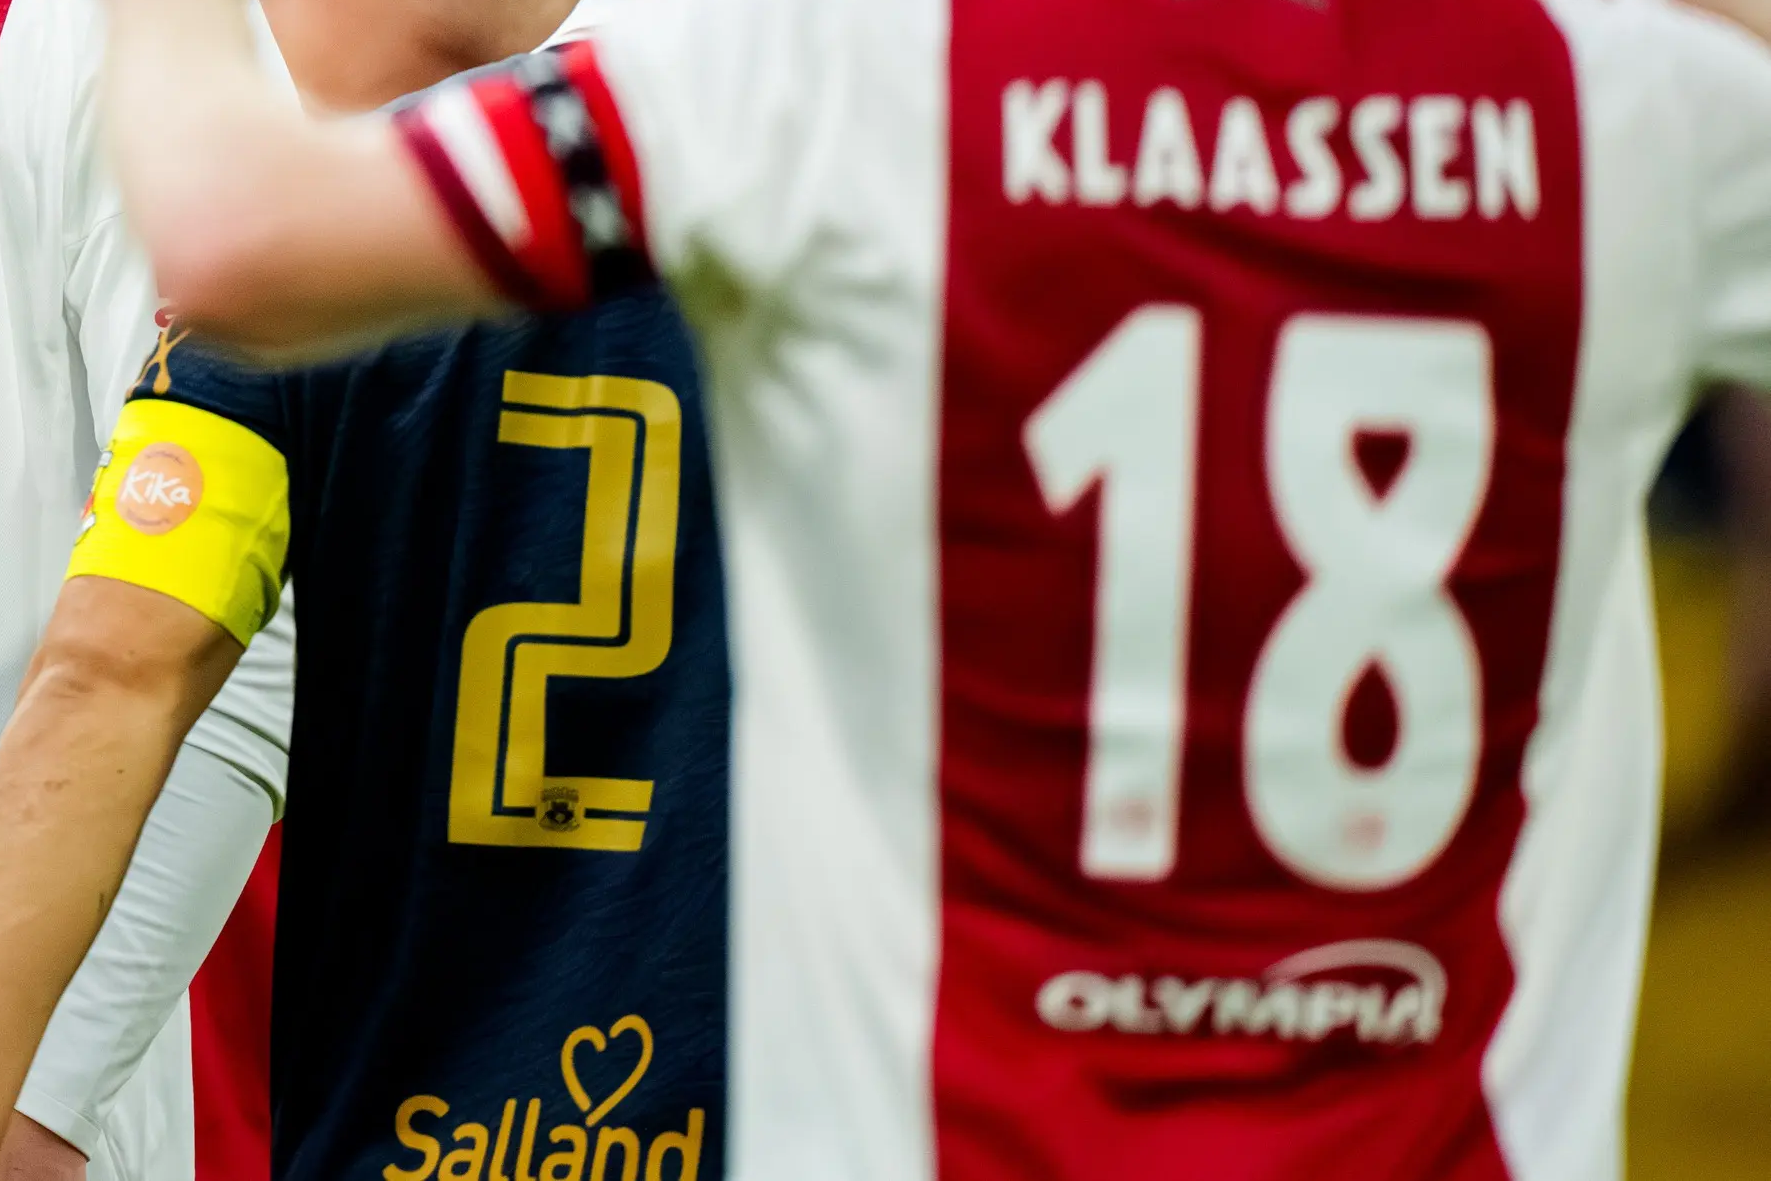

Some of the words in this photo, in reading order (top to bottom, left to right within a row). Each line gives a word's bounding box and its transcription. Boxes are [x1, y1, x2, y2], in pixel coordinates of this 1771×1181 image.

[1000, 77, 1541, 223] KLAASSEN
[447, 369, 683, 853] 2
[1022, 300, 1497, 893] 18
[1036, 957, 1444, 1045] OLYMPIA
[382, 1094, 706, 1181] Salland
